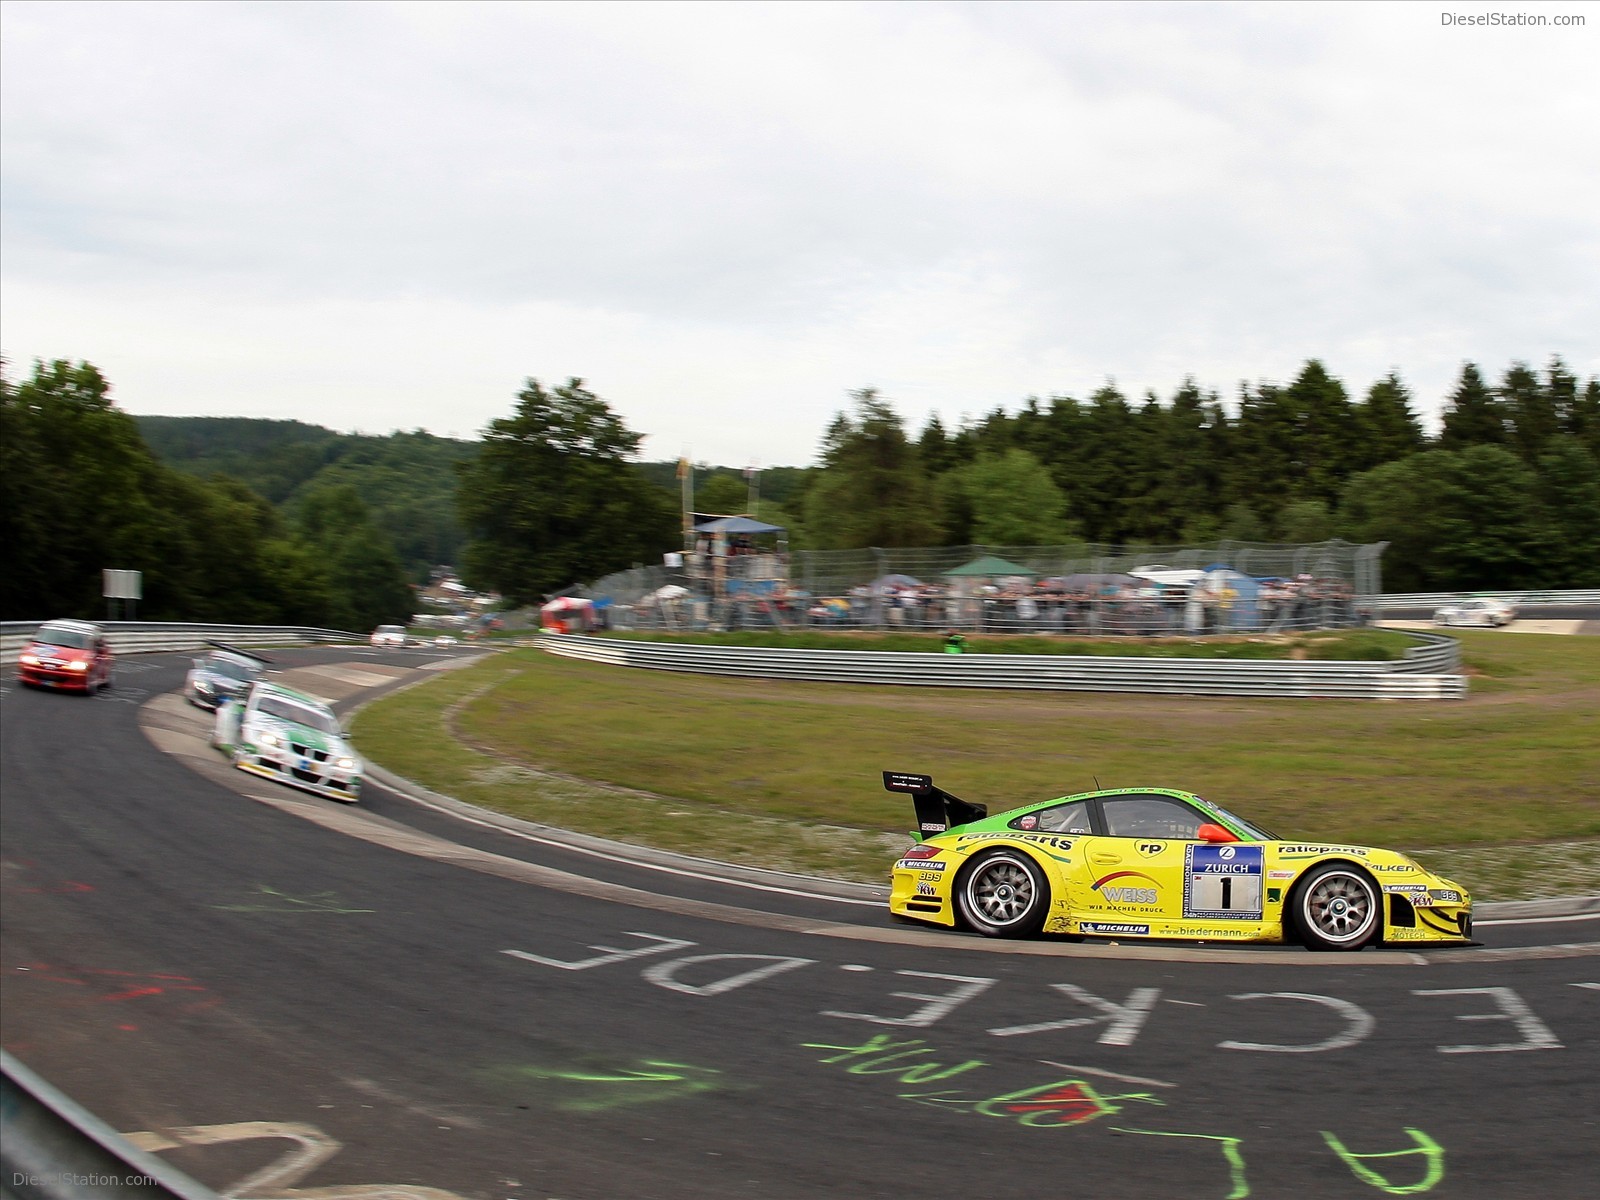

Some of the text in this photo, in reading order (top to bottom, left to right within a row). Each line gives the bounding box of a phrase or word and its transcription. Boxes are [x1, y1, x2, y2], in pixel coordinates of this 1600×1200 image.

[957, 832, 1073, 850] ratioparts
[1140, 844, 1162, 854] rp
[1278, 845, 1367, 856] ratioparts
[906, 861, 944, 869] MICHELIN
[1204, 863, 1249, 873] ZURICH
[1365, 862, 1415, 872] FALKEN
[919, 871, 942, 882] BBS
[919, 886, 937, 896] KW
[1101, 886, 1158, 904] WEISS
[1220, 876, 1232, 910] 1
[1413, 897, 1434, 906] KW
[1096, 924, 1147, 932] MICHELIN
[1159, 926, 1260, 938] www.biedermann.com
